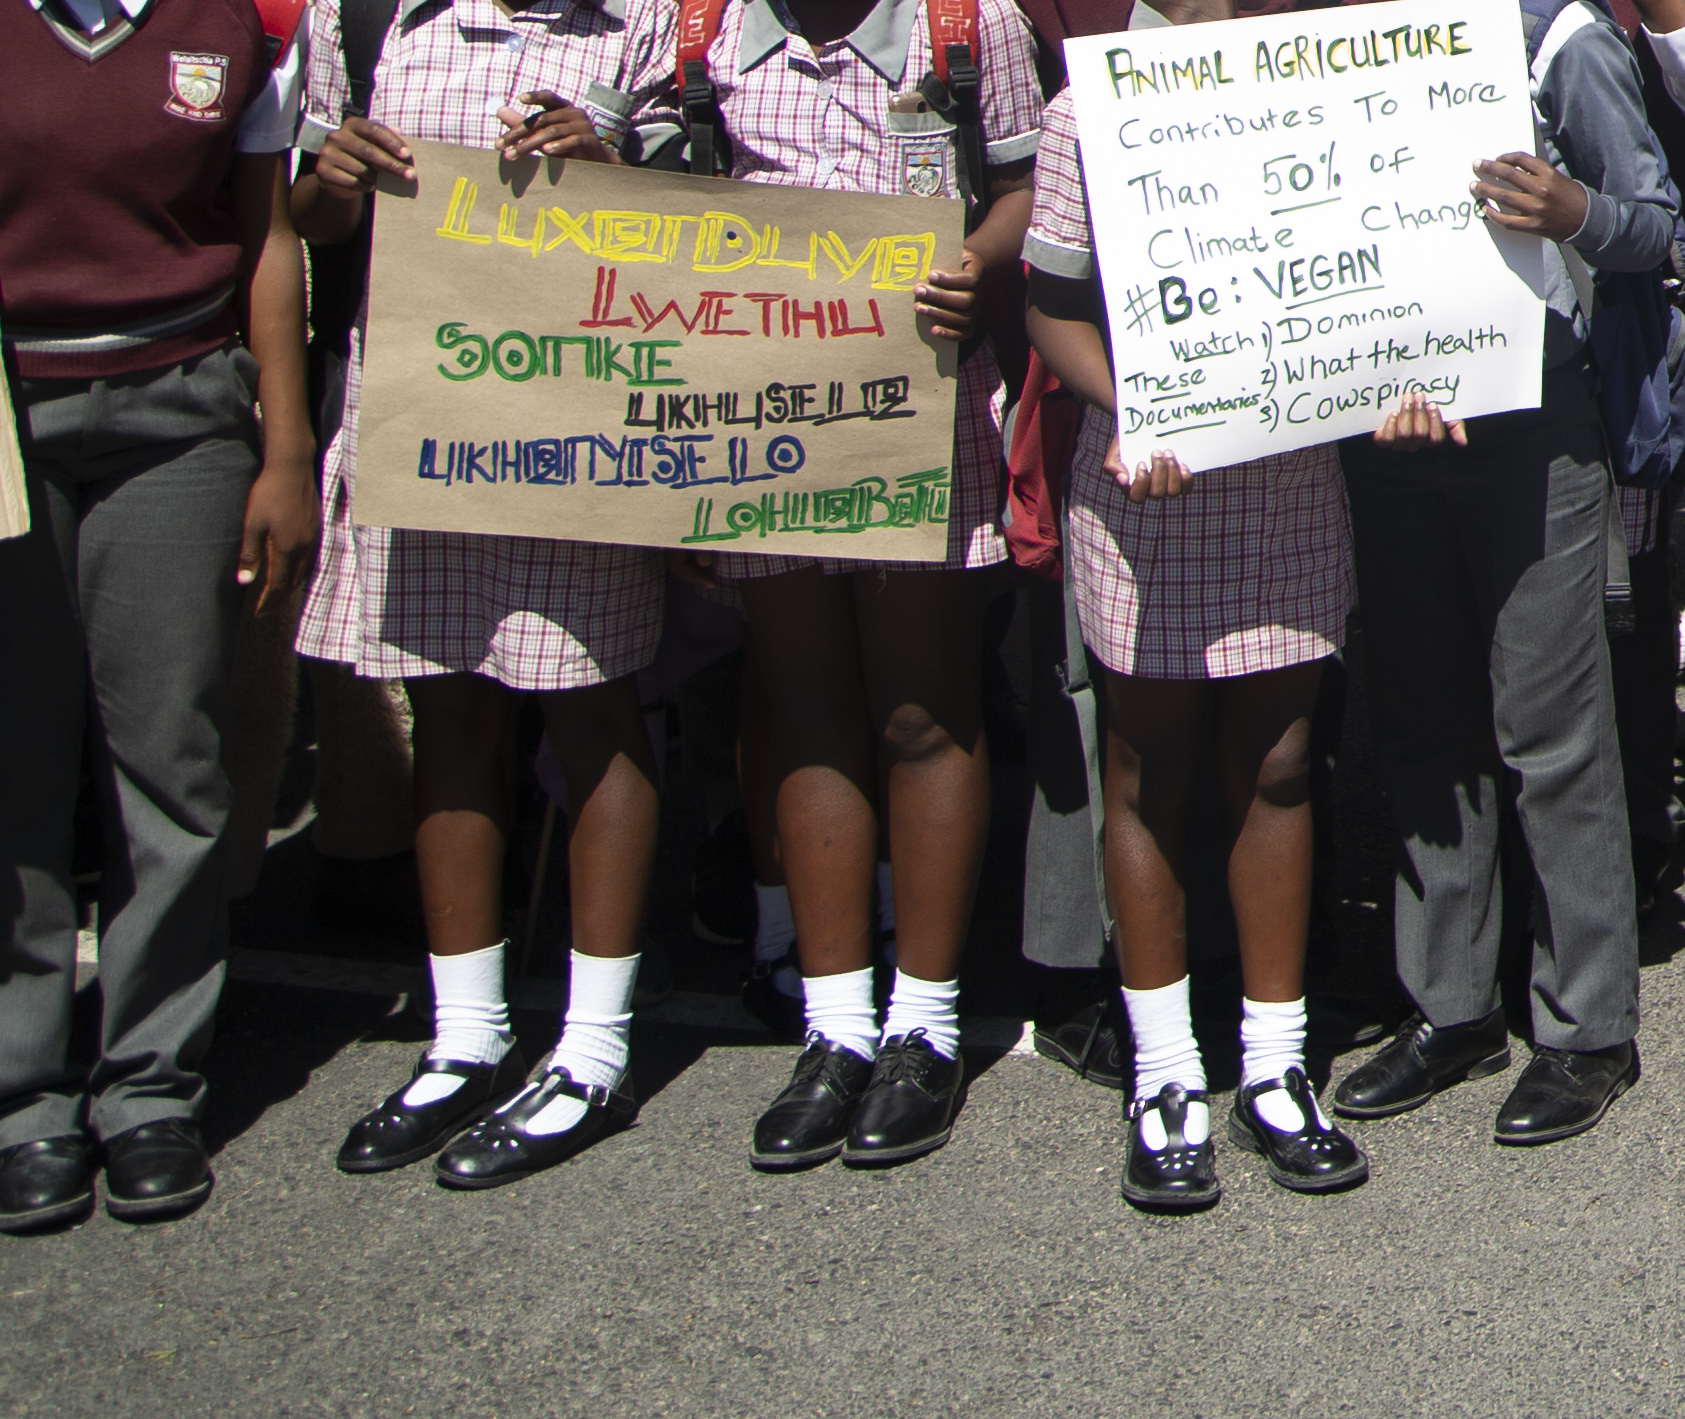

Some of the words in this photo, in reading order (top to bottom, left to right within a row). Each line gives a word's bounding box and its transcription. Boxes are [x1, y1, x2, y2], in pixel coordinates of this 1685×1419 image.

[1106, 47, 1235, 99] ANIMAL
[1255, 21, 1473, 83] AGRICULTURE
[1119, 104, 1325, 148] Contributes
[1354, 91, 1398, 124] To
[1429, 82, 1507, 111] More
[1128, 172, 1220, 216] Than
[1262, 141, 1341, 196] 50%
[1370, 147, 1415, 175] of
[1148, 226, 1295, 269] Climate
[1253, 244, 1384, 301] VEGAN
[1124, 367, 1207, 393] These
[1283, 353, 1364, 386] What
[1373, 337, 1419, 364] the
[1423, 325, 1508, 357] health
[1170, 324, 1255, 362] Watch
[1277, 301, 1424, 345] Dominion
[1124, 391, 1261, 435] Documentaries
[1287, 375, 1461, 426] Cowspiracy
